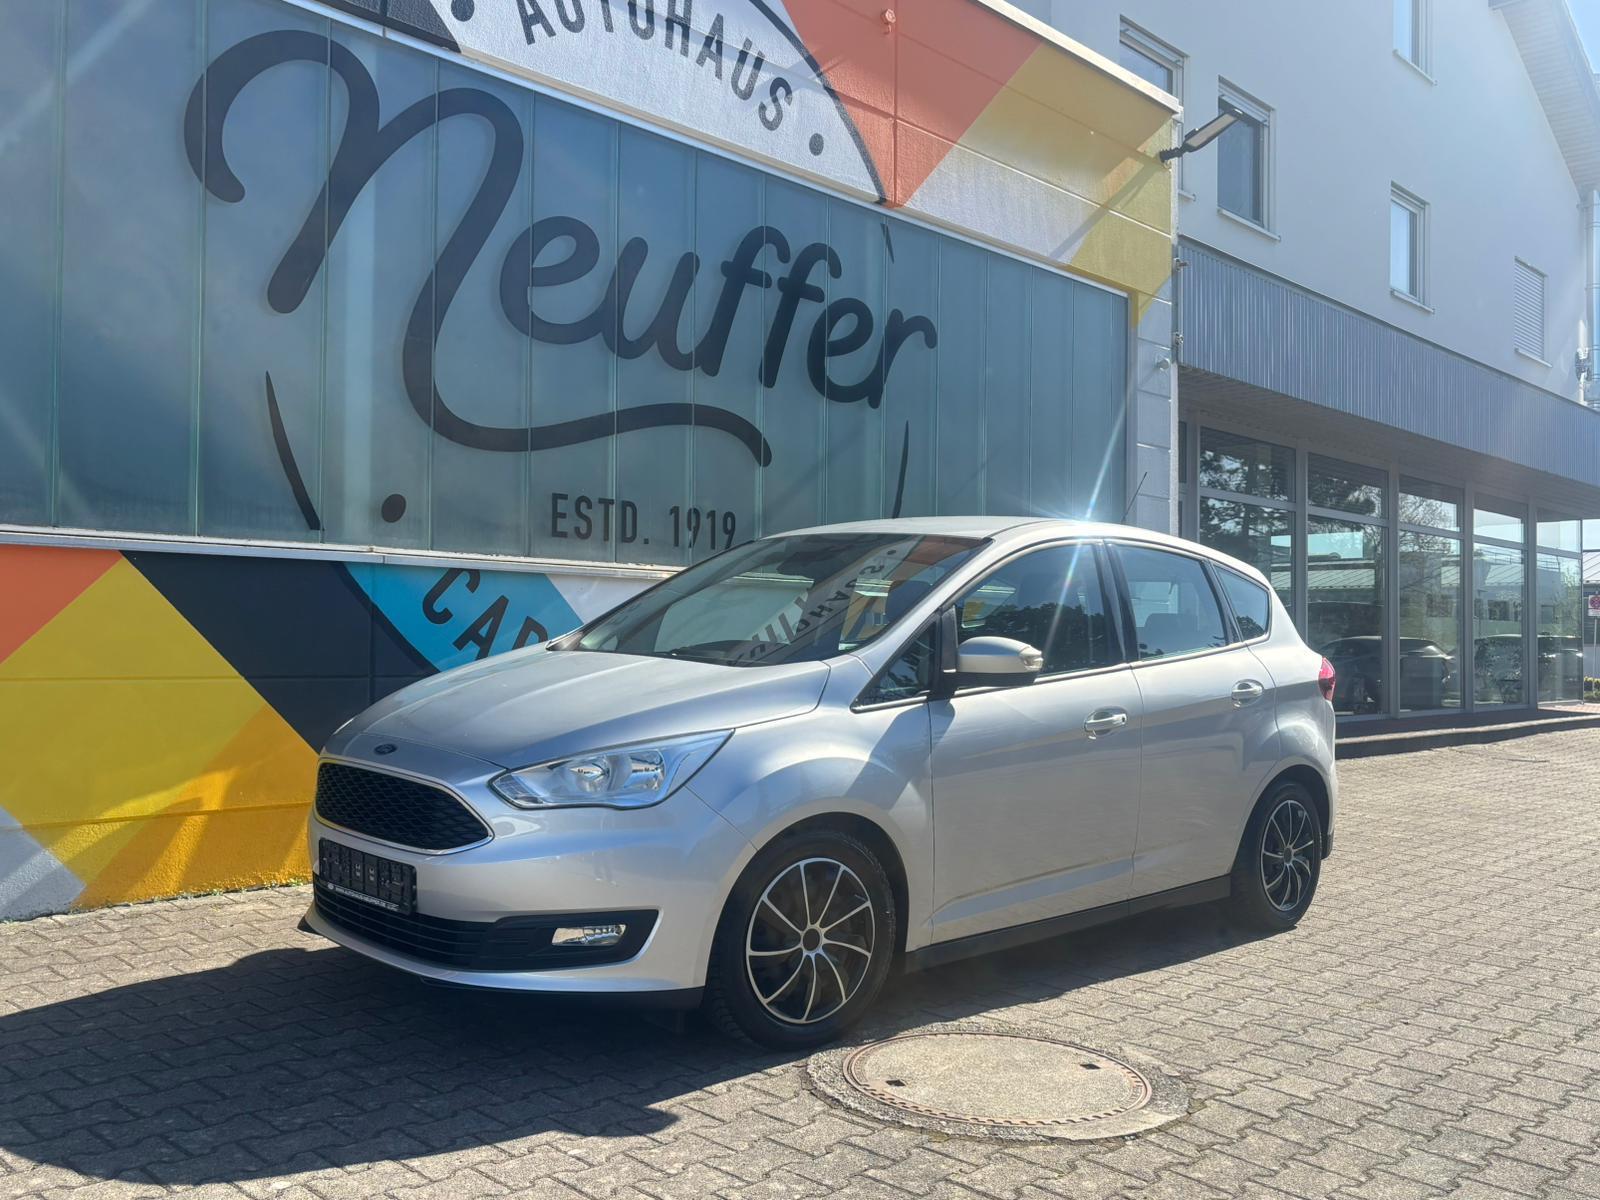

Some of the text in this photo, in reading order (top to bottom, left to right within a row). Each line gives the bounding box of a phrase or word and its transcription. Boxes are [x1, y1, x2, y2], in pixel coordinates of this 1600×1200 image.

[184, 29, 937, 468] Neuffer
[551, 492, 736, 550] ESTD. 1919
